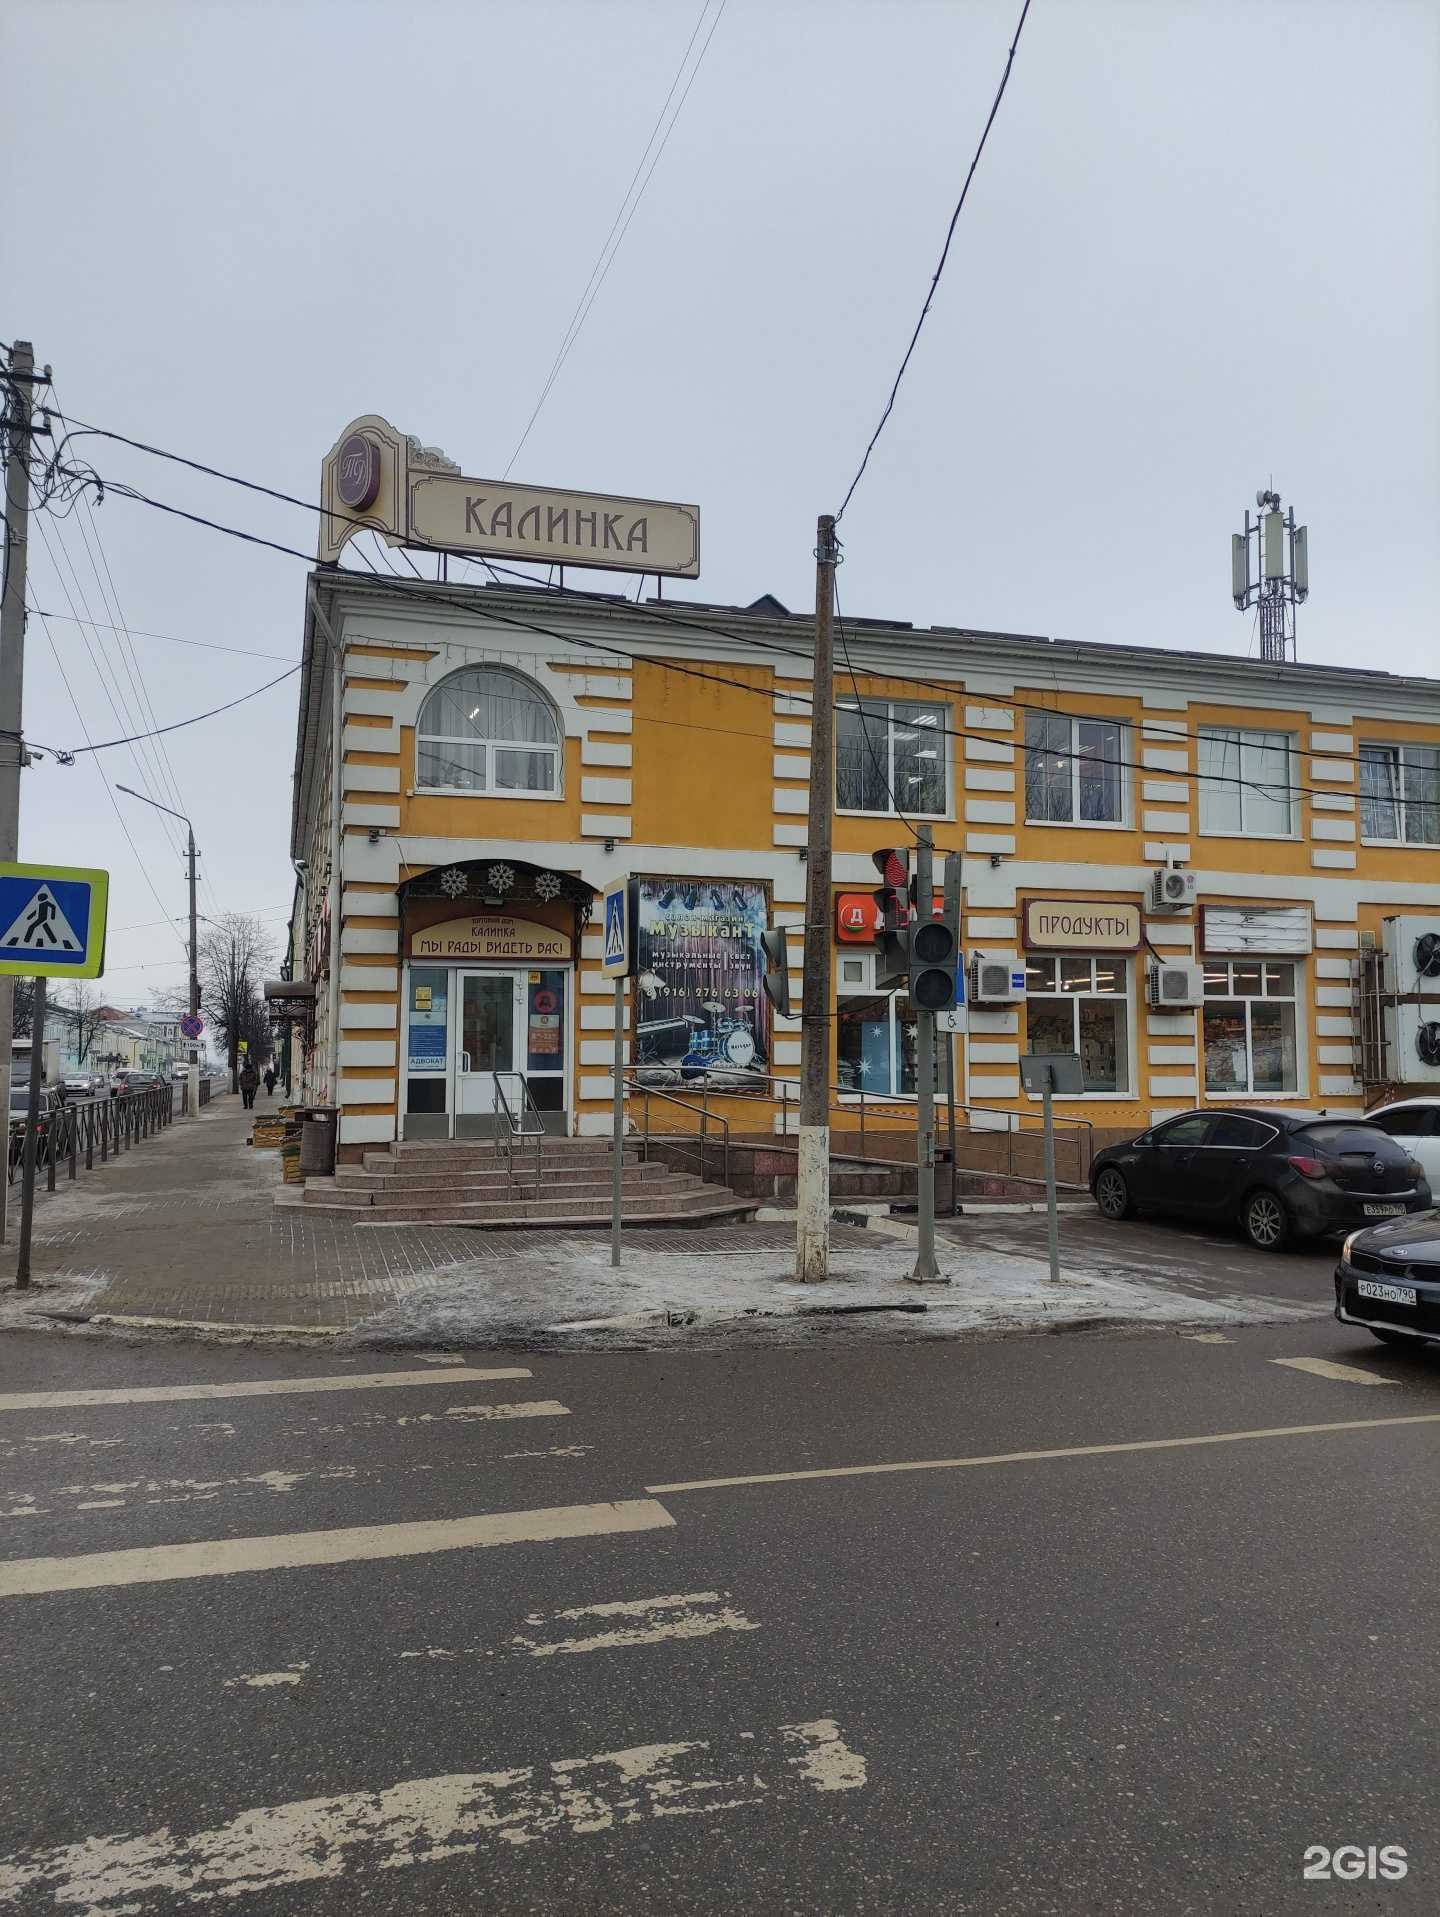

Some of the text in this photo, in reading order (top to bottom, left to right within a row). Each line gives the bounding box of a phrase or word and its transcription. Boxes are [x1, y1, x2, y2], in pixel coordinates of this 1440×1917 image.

[464, 496, 649, 553] КАЛИНКА
[649, 920, 755, 940] Музыкант
[1039, 915, 1129, 936] ПРОДУКТЫ
[471, 927, 516, 937] КАЛИНКА
[420, 940, 563, 954] МЫ РАДЫ ВИДЕТЬ ВАС!
[652, 951, 721, 960] музыкальные
[729, 952, 751, 960] свет
[652, 961, 721, 970] инструменты
[729, 962, 751, 971] звук
[695, 987, 718, 997] 276
[724, 988, 739, 997] 63
[744, 988, 759, 997] 06
[410, 1057, 443, 1065] АДВОКАТ
